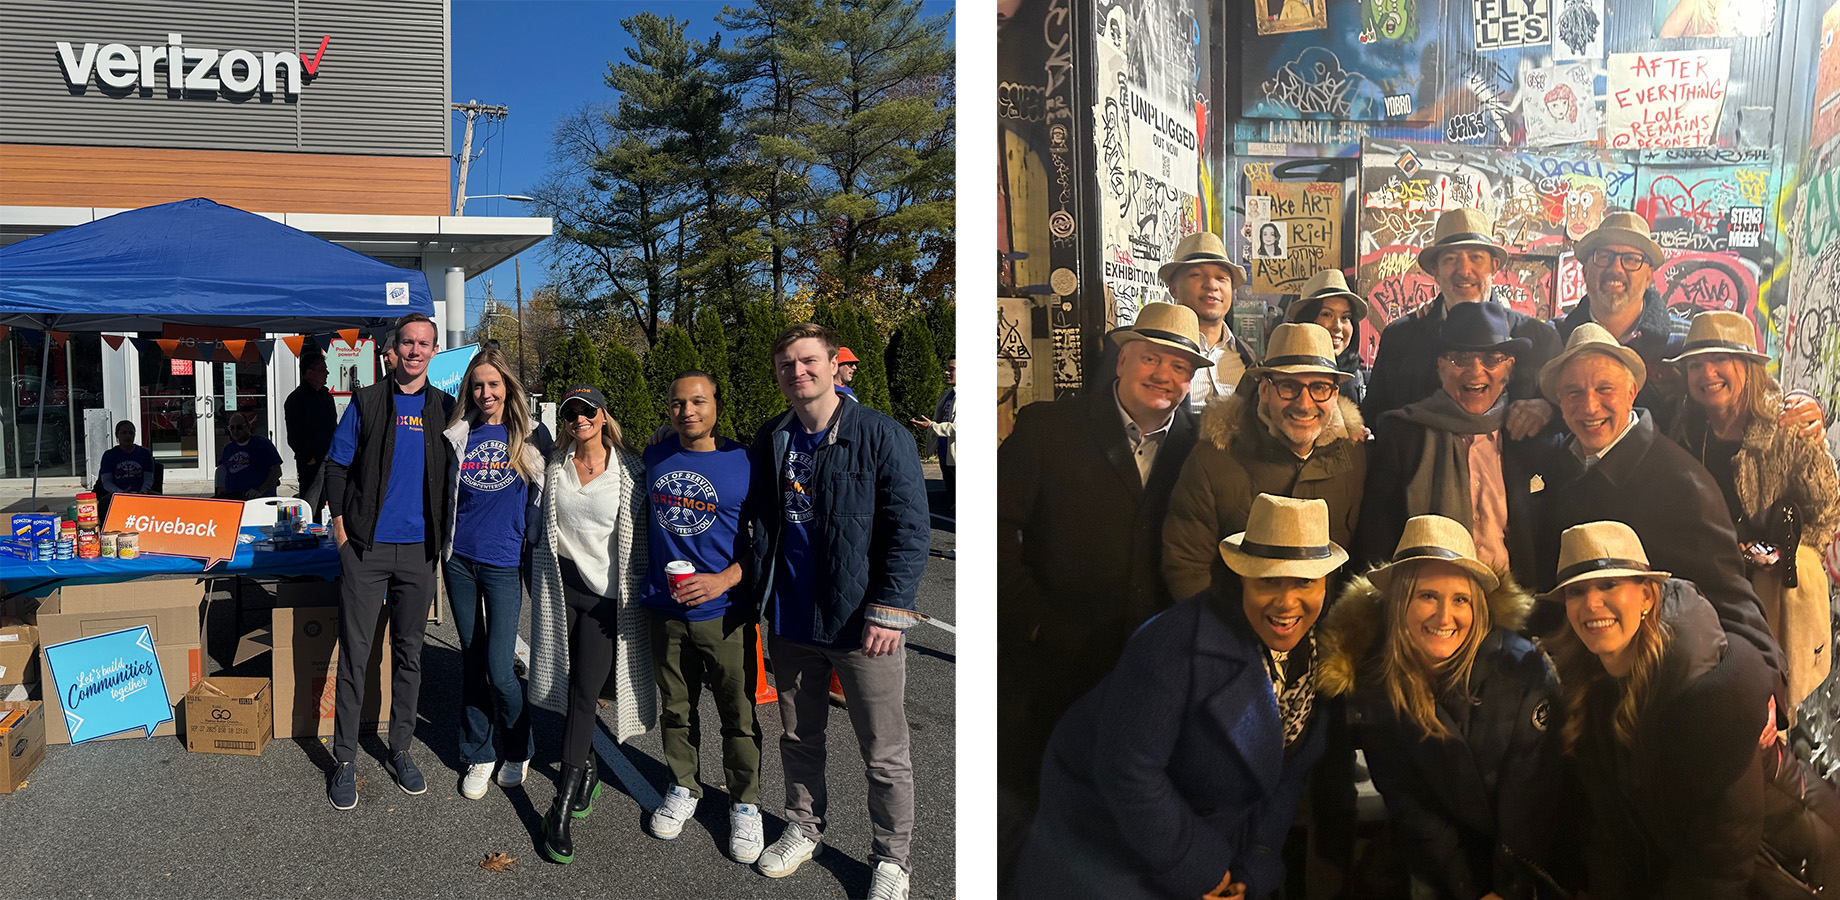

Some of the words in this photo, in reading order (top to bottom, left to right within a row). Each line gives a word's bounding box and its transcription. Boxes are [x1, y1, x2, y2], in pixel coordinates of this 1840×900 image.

[1481, 18, 1543, 44] LES
[56, 33, 301, 95] verizon
[1630, 55, 1709, 79] AFTER
[1384, 94, 1412, 117] YOBRO
[1643, 106, 1685, 126] LOVE
[1130, 90, 1196, 152] UNPLUGGED
[1153, 133, 1165, 150] OUT
[1302, 189, 1333, 216] ART
[1728, 231, 1760, 248] MEEK
[1105, 261, 1156, 286] EXHIBITION
[490, 441, 508, 452] SERV
[655, 475, 669, 489] DAY
[685, 473, 715, 498] SERVICE
[653, 493, 716, 513] BRIXMOR
[124, 514, 218, 537] #Giveback
[68, 660, 153, 710] Communities
[76, 668, 101, 688] Let's
[101, 657, 125, 676] build
[110, 676, 148, 702] together
